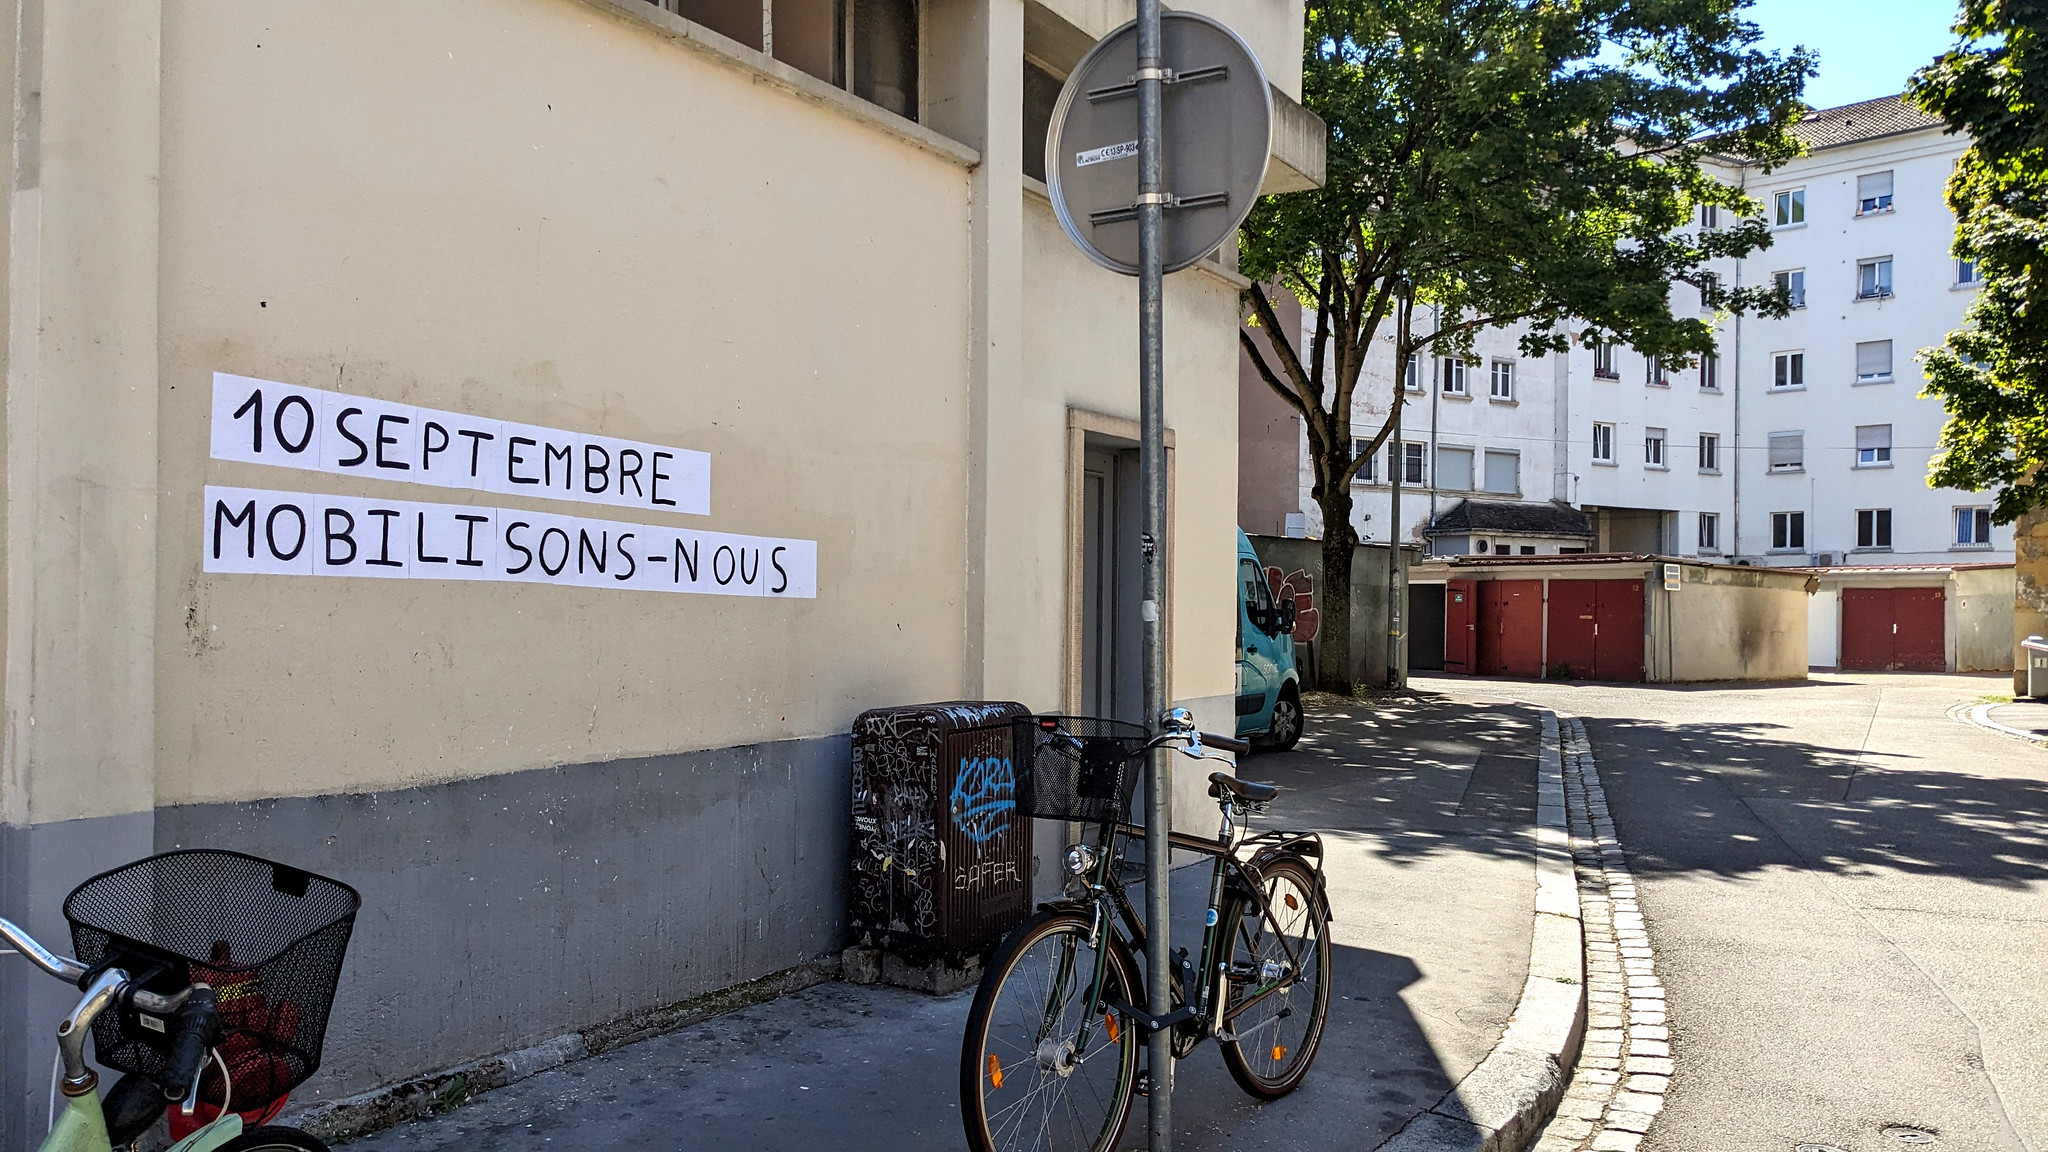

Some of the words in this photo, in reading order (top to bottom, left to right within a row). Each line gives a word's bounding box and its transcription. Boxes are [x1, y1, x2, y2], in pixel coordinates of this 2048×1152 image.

[233, 388, 315, 454] 10
[336, 407, 677, 506] SEPTEMBRE
[212, 499, 789, 594] MOBILISONS-NOUS
[955, 860, 1021, 891] SAFER
